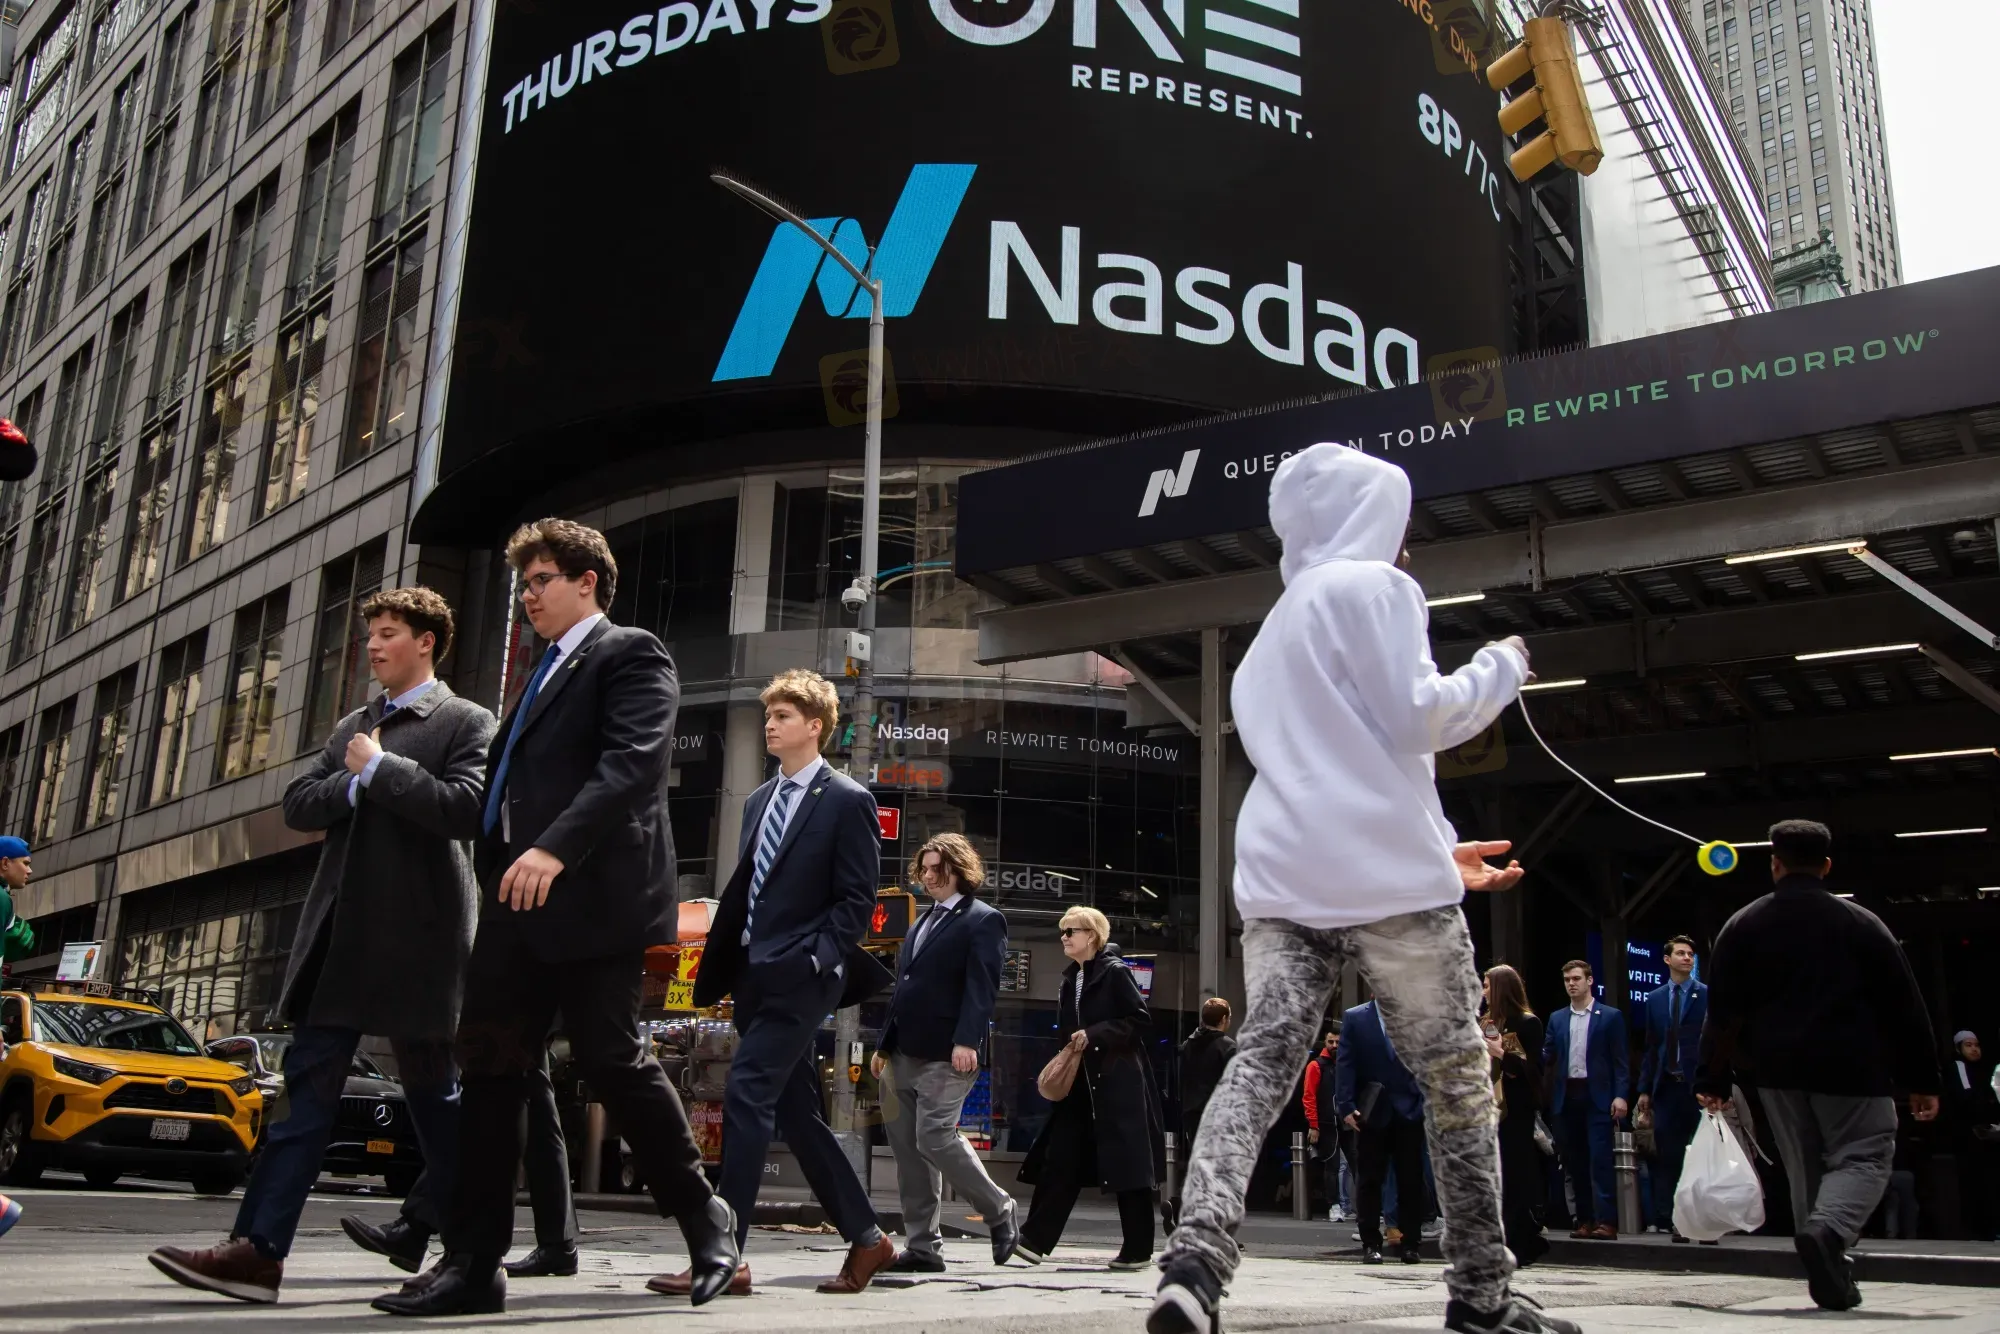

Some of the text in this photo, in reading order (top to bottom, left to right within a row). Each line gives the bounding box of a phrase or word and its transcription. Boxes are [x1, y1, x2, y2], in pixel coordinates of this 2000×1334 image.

[1072, 64, 1313, 139] REPRESENT.
[1224, 437, 1363, 479] QUEN
[1379, 417, 1475, 451] TODAY
[1507, 380, 1669, 427] REWRITE
[878, 724, 949, 745] Nasdaq
[986, 730, 1179, 762] REWRITE TOMORROW
[983, 866, 1063, 898] asdaq
